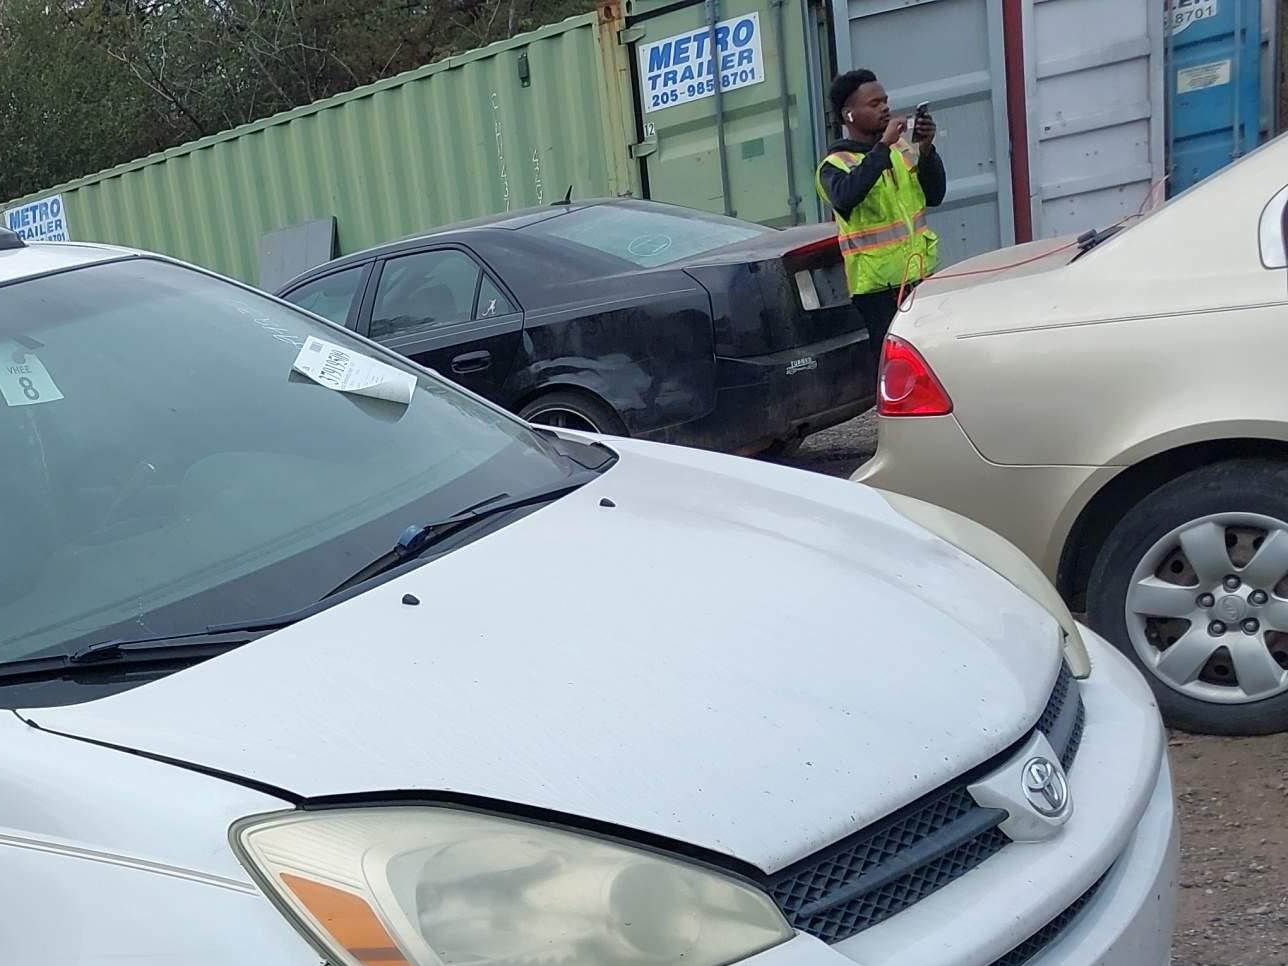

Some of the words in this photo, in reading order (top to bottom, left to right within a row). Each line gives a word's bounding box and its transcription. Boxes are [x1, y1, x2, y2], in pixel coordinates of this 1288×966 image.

[649, 19, 754, 73] METRO
[652, 67, 755, 107] 205-9858701
[10, 198, 61, 230] METRO
[18, 219, 62, 241] RAILER
[18, 376, 40, 400] 8
